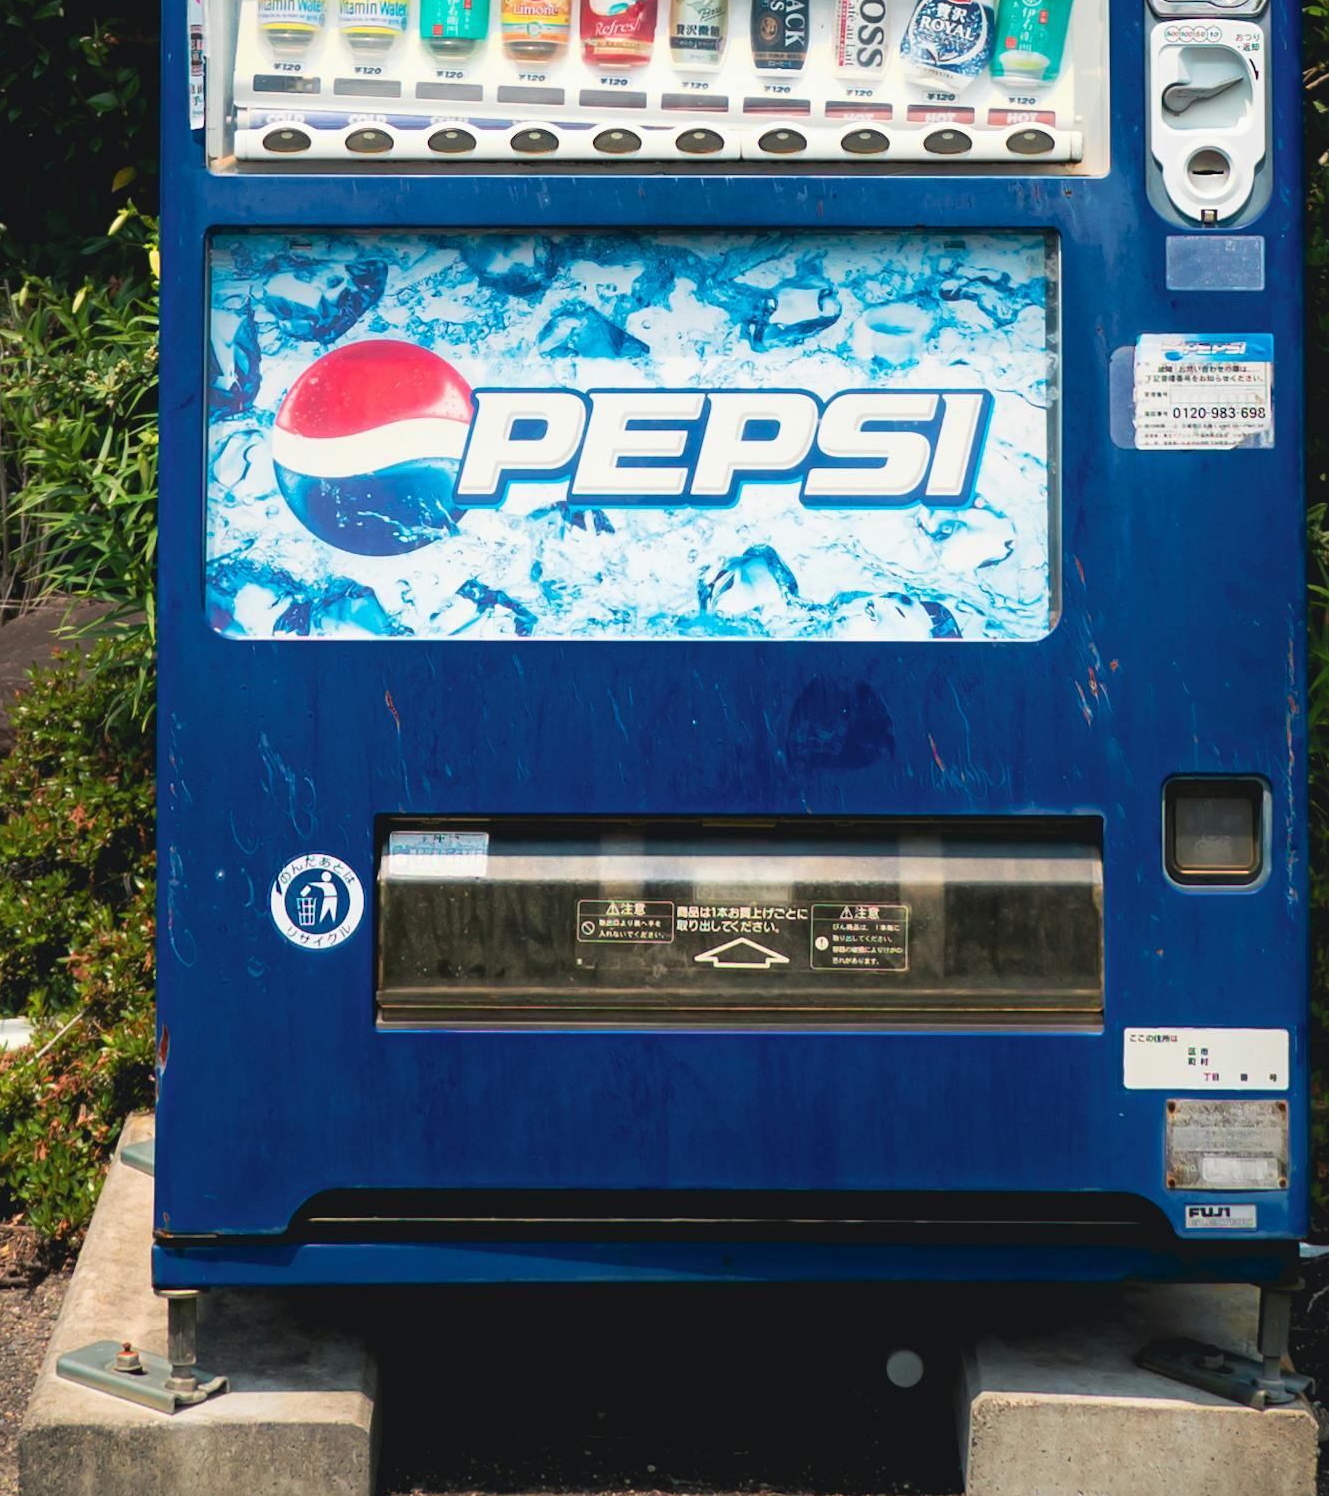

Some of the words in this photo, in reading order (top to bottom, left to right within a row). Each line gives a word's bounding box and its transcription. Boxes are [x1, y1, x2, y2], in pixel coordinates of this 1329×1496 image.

[380, 0, 408, 17] Water
[594, 18, 641, 36] Refresh
[676, 24, 720, 36] 贅沢微糖
[920, 15, 974, 40] ROYAL
[1235, 33, 1260, 42] おつり
[273, 63, 301, 71] ¥120
[354, 66, 382, 75] ¥120
[436, 70, 463, 79] ¥120
[519, 74, 545, 82] ¥120
[600, 77, 628, 86] ¥120
[682, 81, 709, 89] ¥120
[764, 85, 791, 94] ¥120
[846, 89, 873, 97] ¥120
[927, 93, 955, 101] ¥120
[1008, 97, 1035, 105] ¥120
[925, 113, 956, 122] HOT
[1007, 113, 1037, 123] HOT
[457, 389, 994, 508] PEPSI
[279, 855, 356, 885] のんだあとは
[621, 902, 646, 916] 注意
[676, 906, 808, 921] 商品は1本お買上げごとに
[854, 906, 880, 920] 注意
[676, 919, 780, 934] 取り出してください。
[286, 923, 352, 946] リサイクル
[1129, 1034, 1178, 1043] ここの住所は
[1200, 1058, 1209, 1066] 村
[1203, 1073, 1219, 1081] 丁目
[1269, 1073, 1277, 1082] 号
[1188, 1207, 1231, 1218] FUJI
